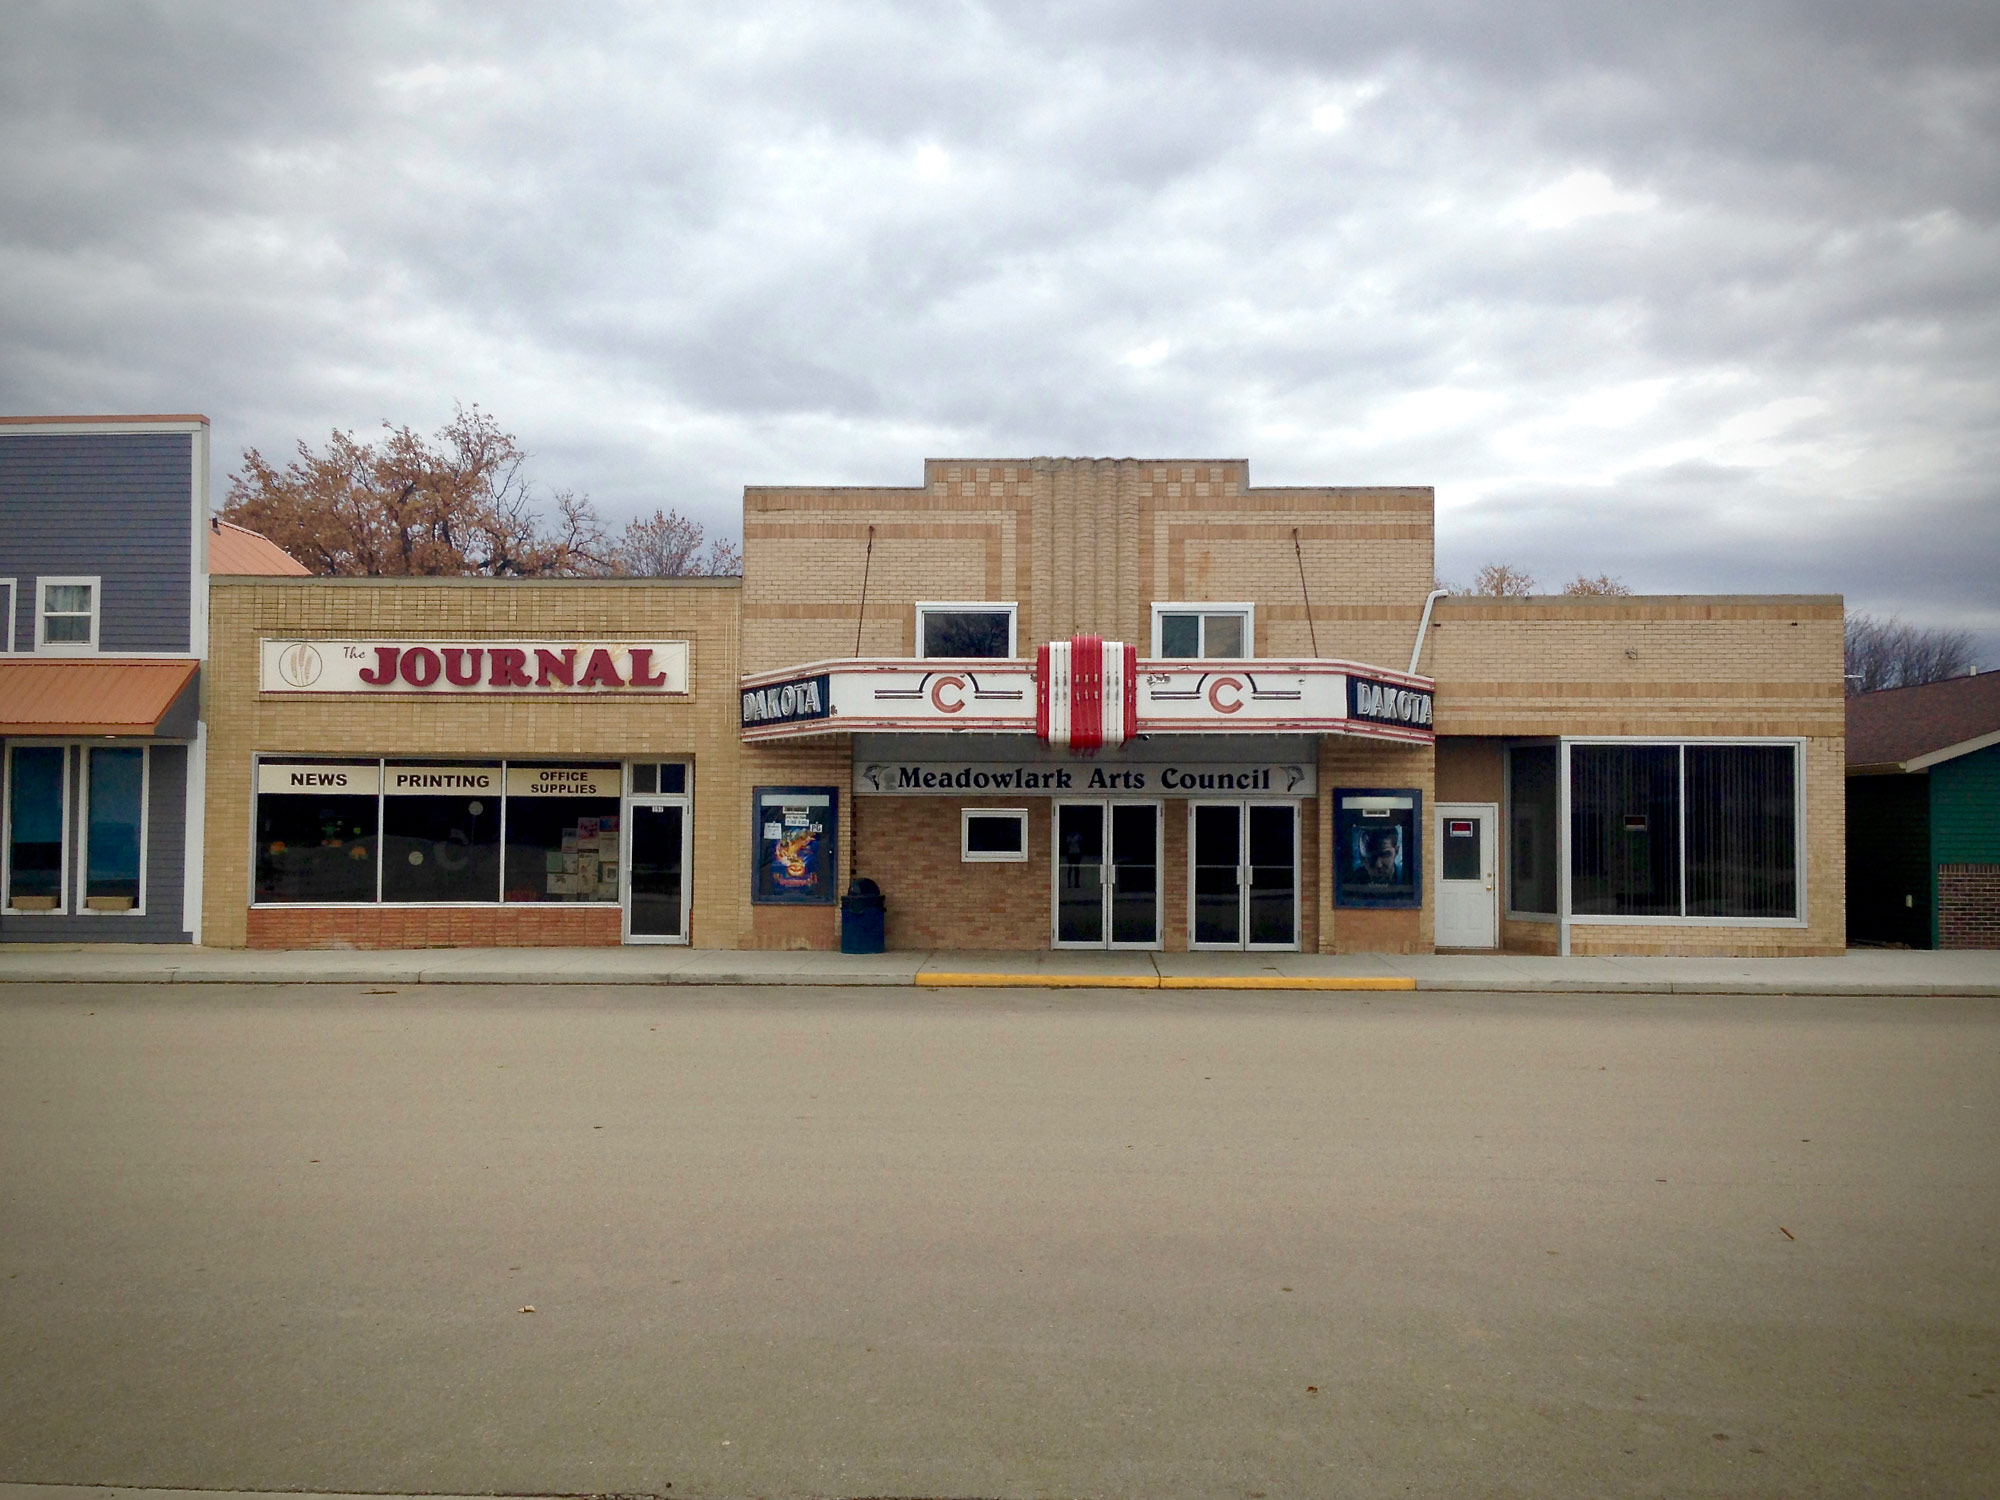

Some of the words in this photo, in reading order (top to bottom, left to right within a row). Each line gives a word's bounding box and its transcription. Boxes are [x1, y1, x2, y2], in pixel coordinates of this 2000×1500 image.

[343, 646, 365, 659] The
[359, 647, 667, 687] JOURNAL
[743, 681, 821, 721] DAKOTA
[931, 676, 966, 714] C
[1209, 677, 1244, 714] C
[1357, 682, 1433, 724] DAKOTA
[291, 773, 347, 787] NEWS
[396, 775, 490, 788] PRINTING
[531, 784, 597, 794] SUPPLIES
[540, 771, 588, 781] OFFICE
[898, 767, 1072, 789] Meadowlark
[1088, 768, 1145, 789] Arts
[1161, 768, 1271, 790] Council
